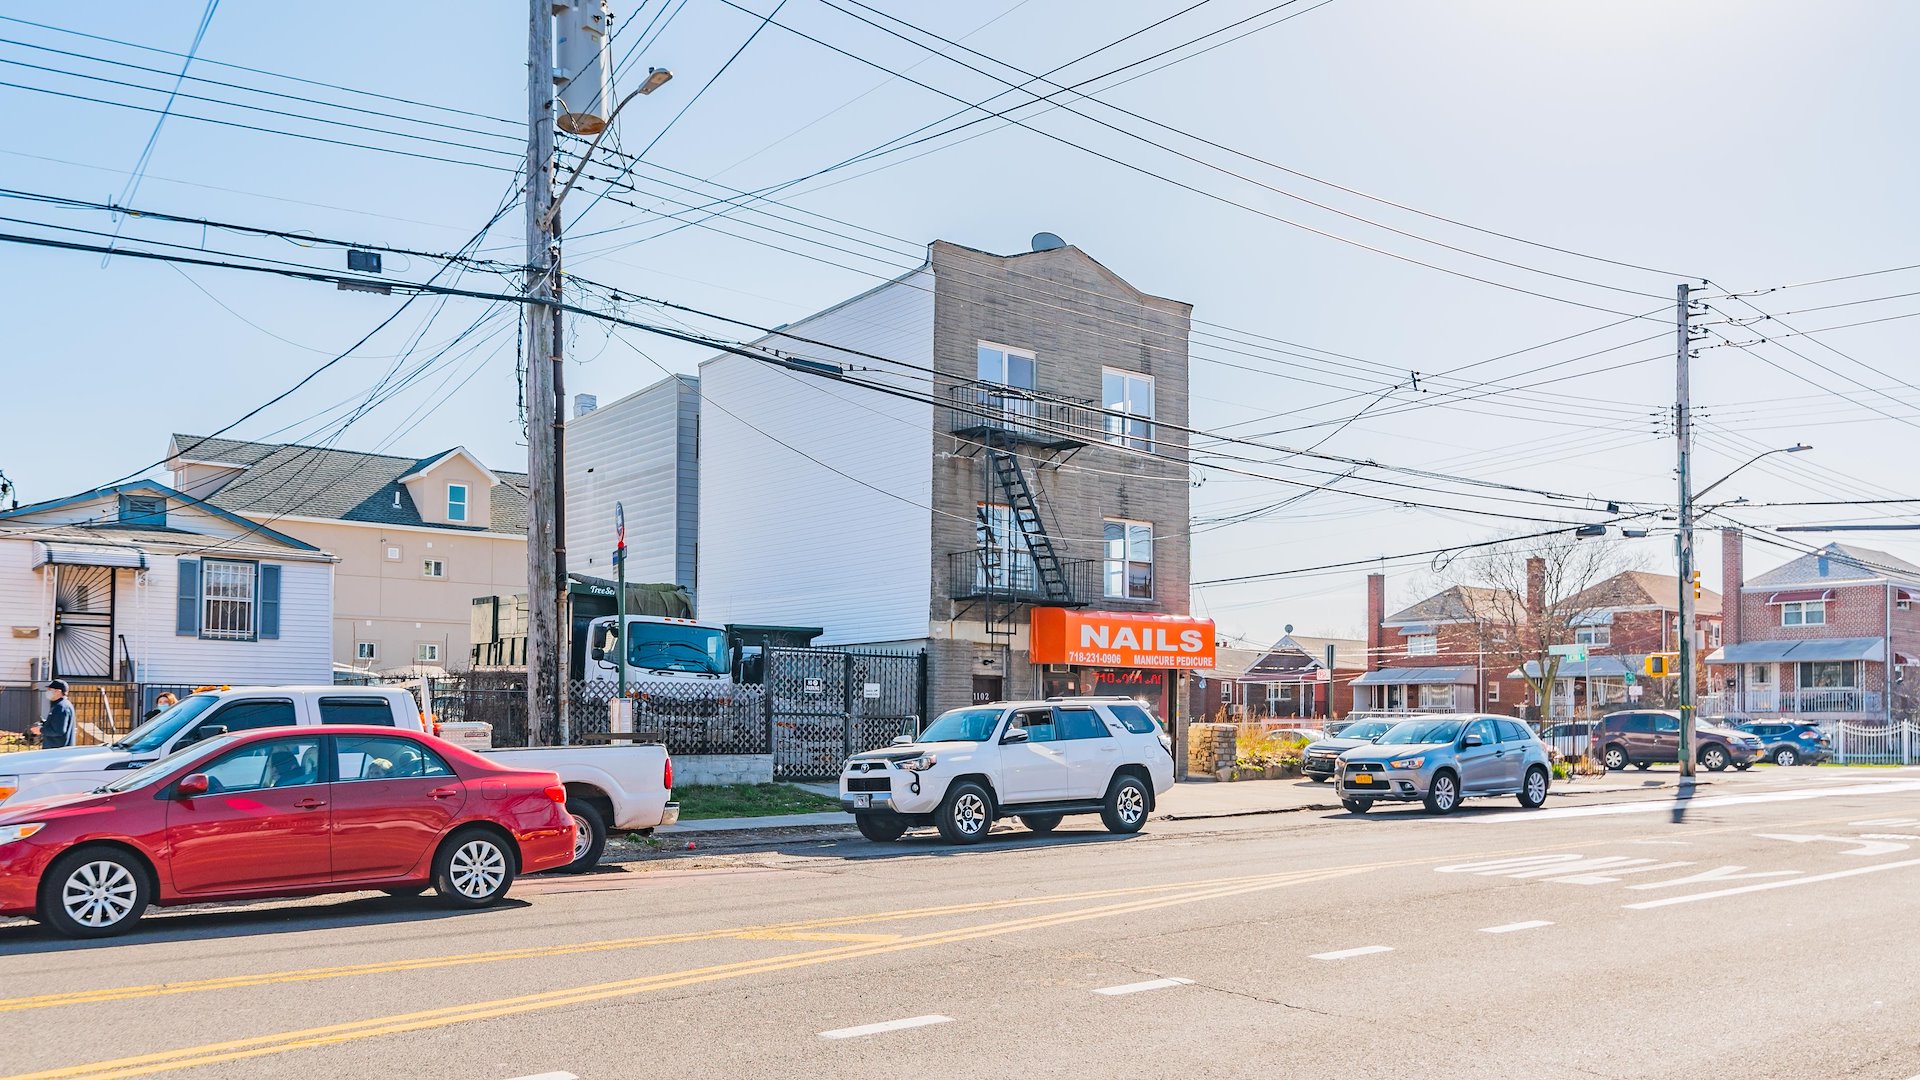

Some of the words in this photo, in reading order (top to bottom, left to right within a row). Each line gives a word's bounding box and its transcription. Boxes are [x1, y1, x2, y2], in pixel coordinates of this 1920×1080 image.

[1081, 624, 1203, 653] NAILS
[1069, 651, 1121, 664] 718-231-0906
[1134, 654, 1175, 666] MANICURE
[1176, 656, 1213, 667] PEDICURE
[973, 692, 989, 700] 1102
[1434, 854, 1805, 889] ONLY
